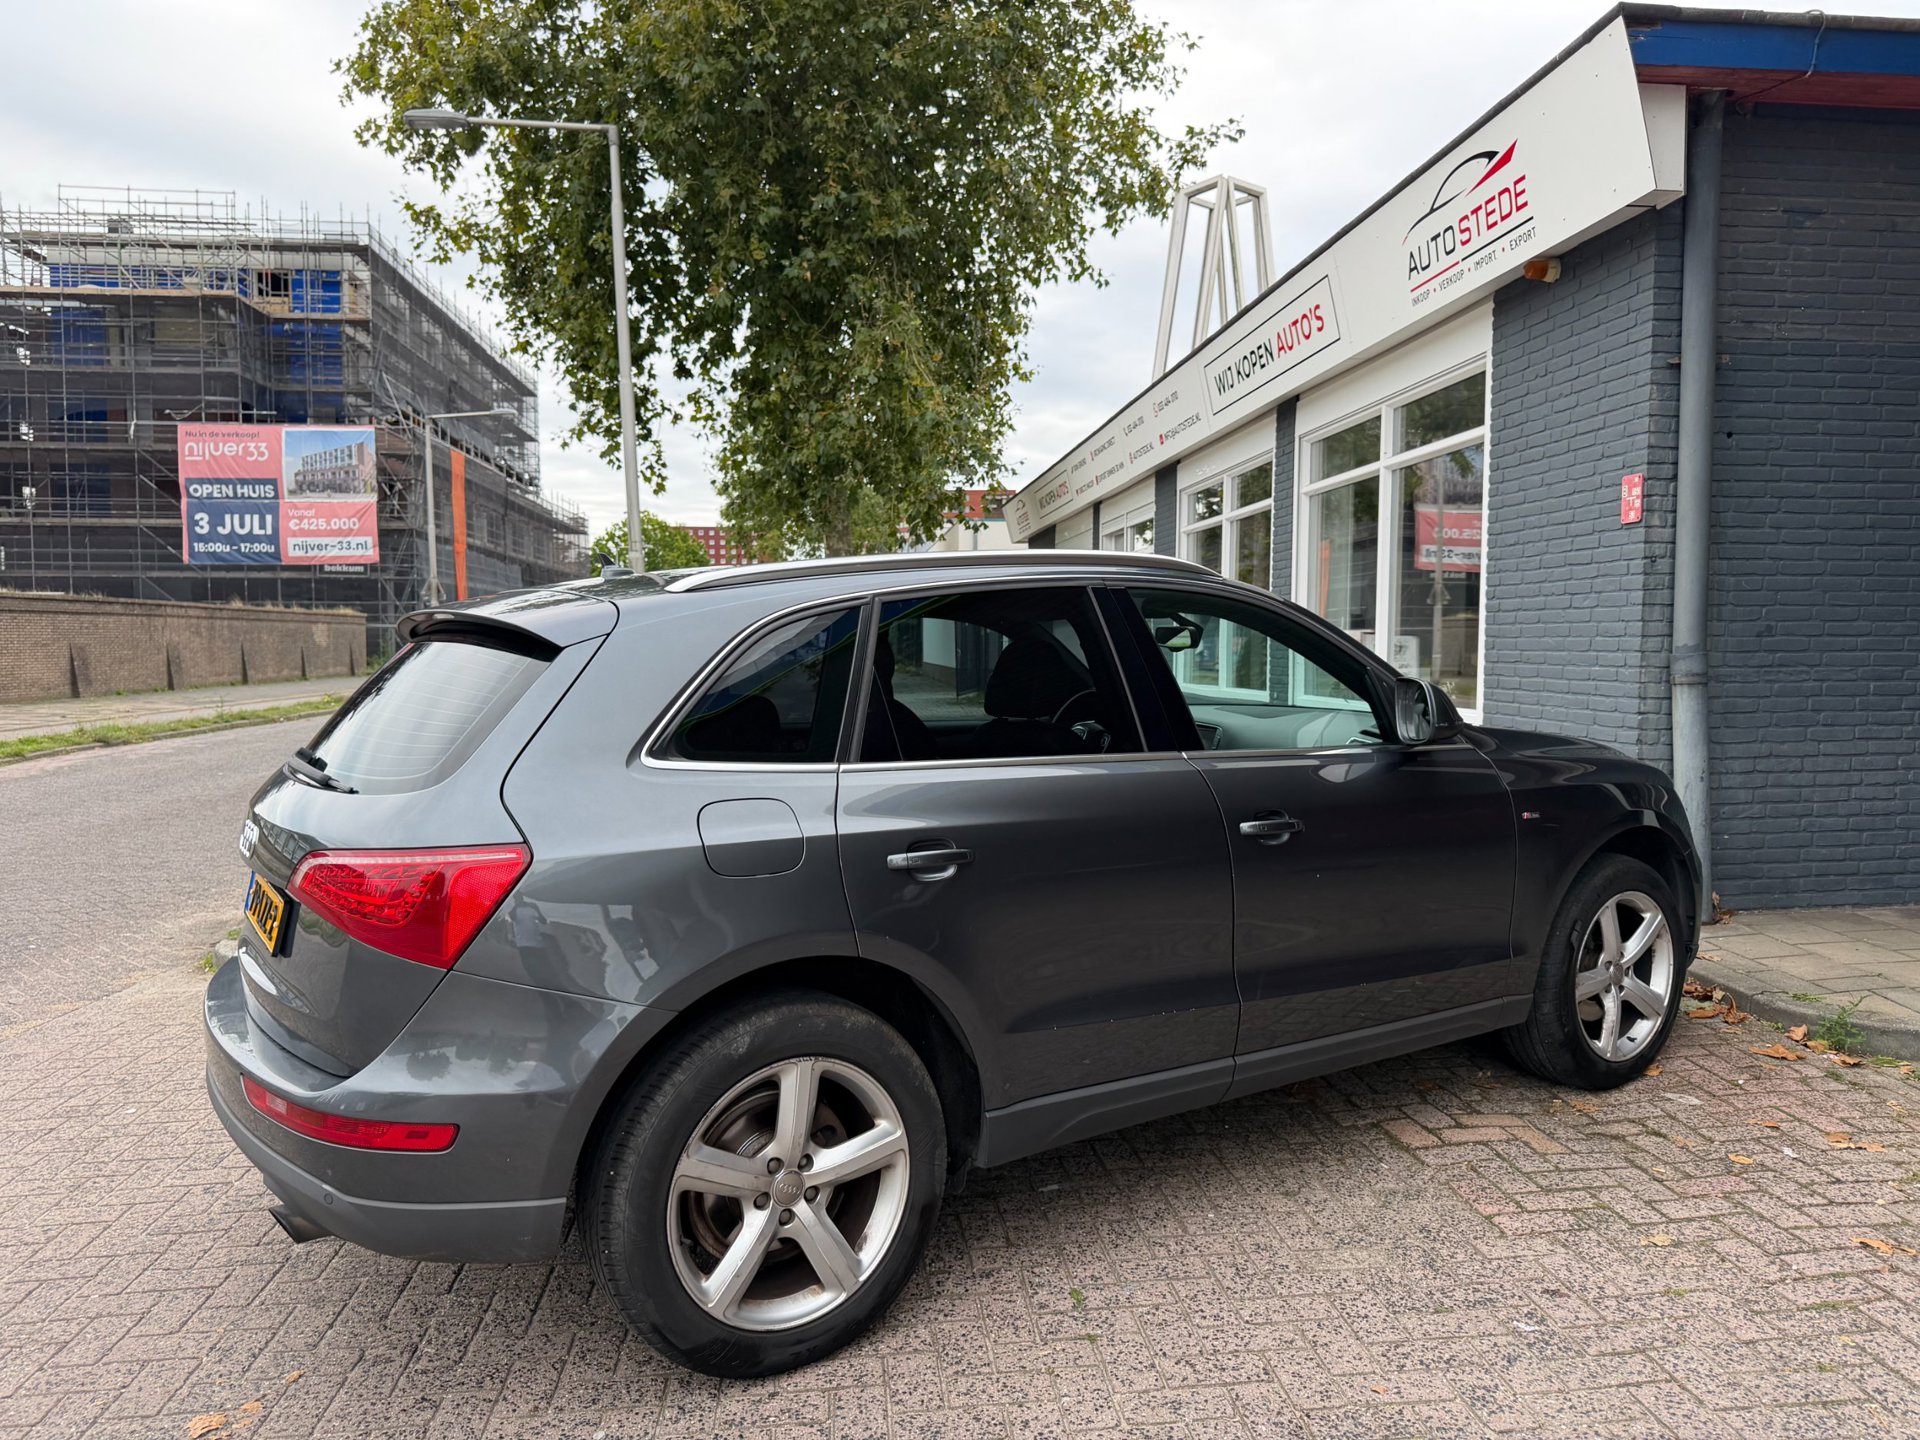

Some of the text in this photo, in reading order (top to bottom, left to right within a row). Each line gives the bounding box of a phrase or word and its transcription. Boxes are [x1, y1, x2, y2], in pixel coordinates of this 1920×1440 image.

[1411, 226, 1537, 308] INKOOP VERKOOP IMPORT EXPORT
[1214, 303, 1325, 397] WIJ KOPEN AUTO'S
[185, 430, 260, 440] Nu in de verkoop!
[188, 483, 275, 498] OPEN HUIS
[287, 508, 316, 518] Vanaf
[193, 511, 273, 536] 3 JULI
[288, 517, 360, 531] €425.000
[193, 542, 231, 553] 15:00u
[239, 542, 275, 553] 17:00u
[292, 540, 369, 555] nijver-33.nl
[324, 564, 365, 573] bekkum
